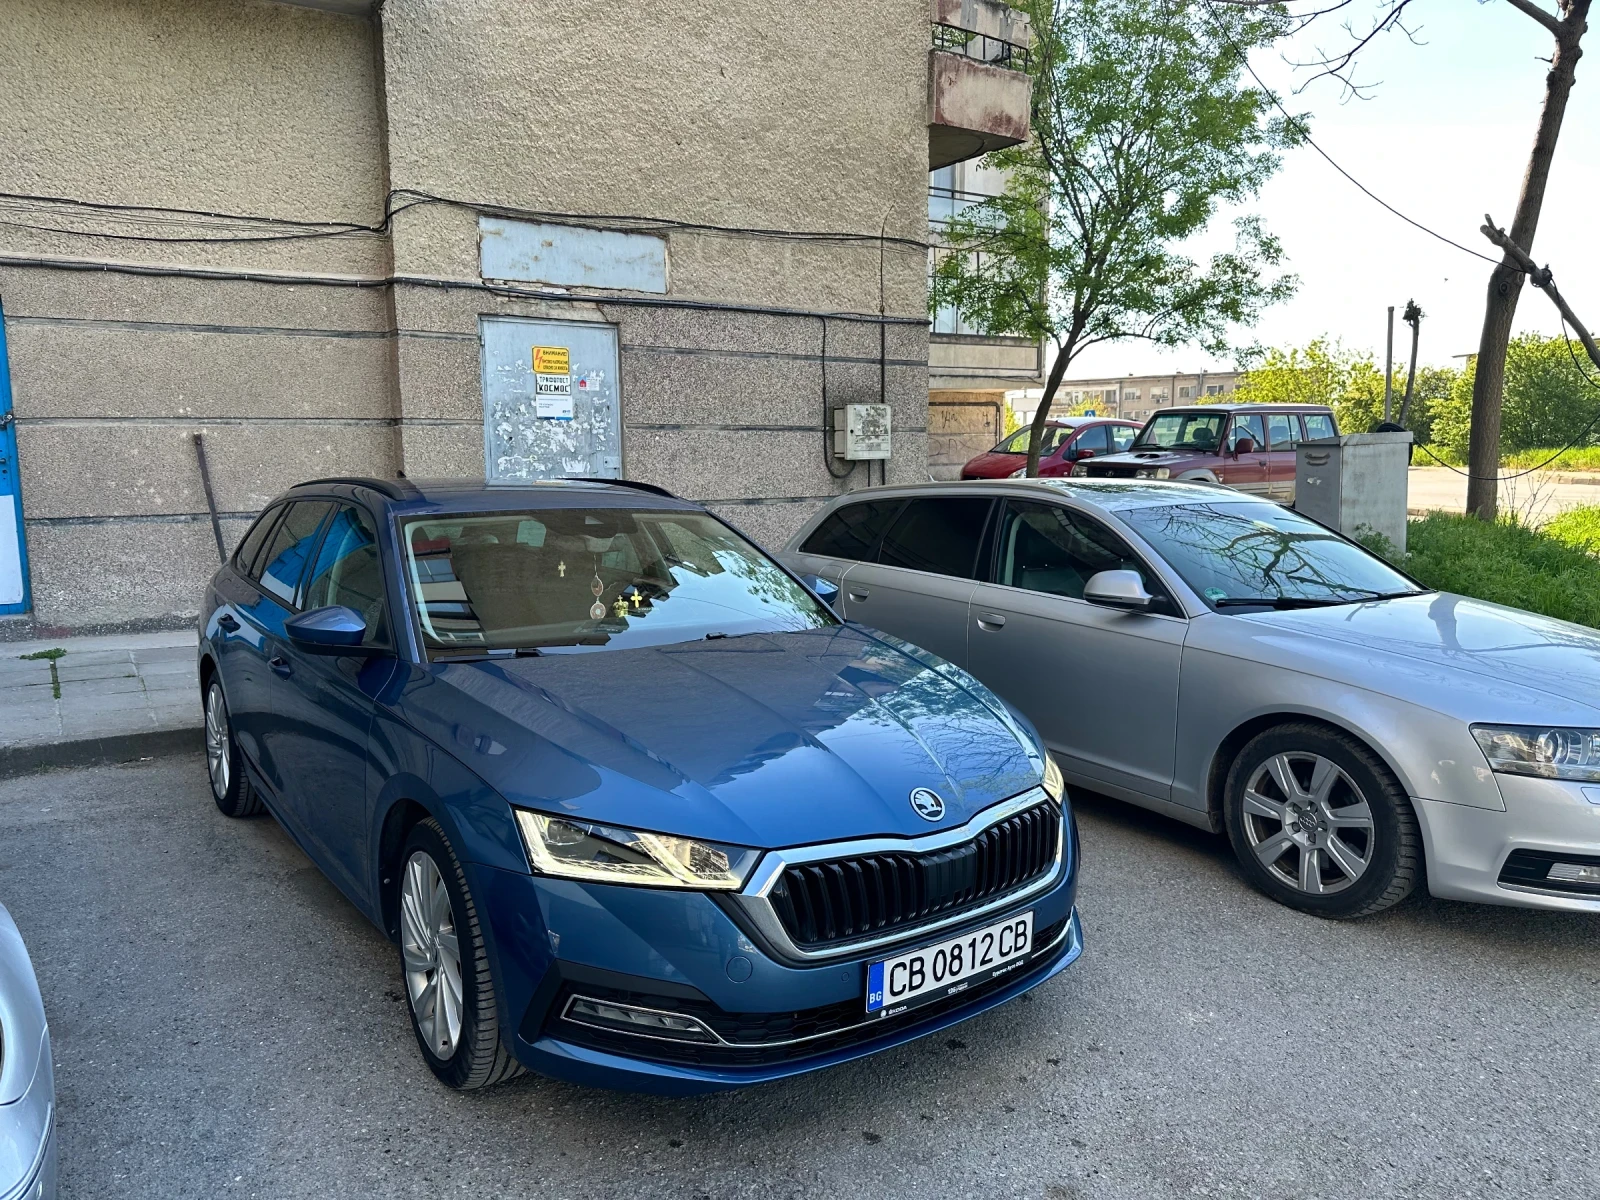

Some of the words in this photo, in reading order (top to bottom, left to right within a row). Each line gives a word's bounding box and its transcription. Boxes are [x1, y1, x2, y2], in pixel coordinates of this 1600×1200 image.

[539, 384, 569, 392] КОСМОС
[889, 956, 926, 997] CB
[932, 932, 994, 983] 0812
[999, 919, 1028, 958] CB
[869, 991, 882, 1004] BG
